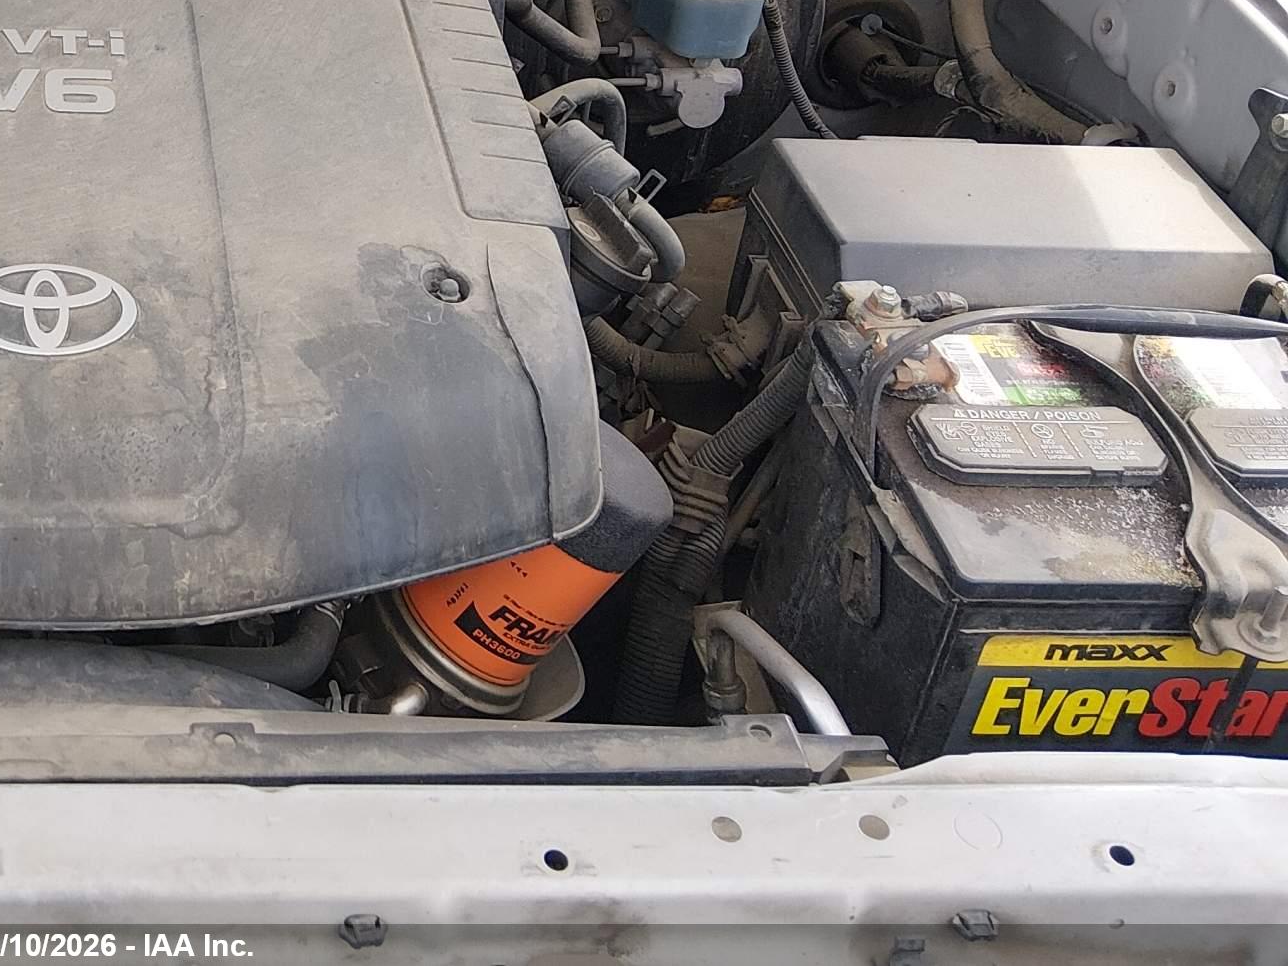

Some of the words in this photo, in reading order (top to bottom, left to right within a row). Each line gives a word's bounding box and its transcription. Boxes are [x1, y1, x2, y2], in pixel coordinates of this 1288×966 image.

[969, 409, 1029, 420] DANGER
[1046, 411, 1102, 421] POISON
[472, 628, 521, 660] PH3600
[1044, 644, 1175, 662] maxx
